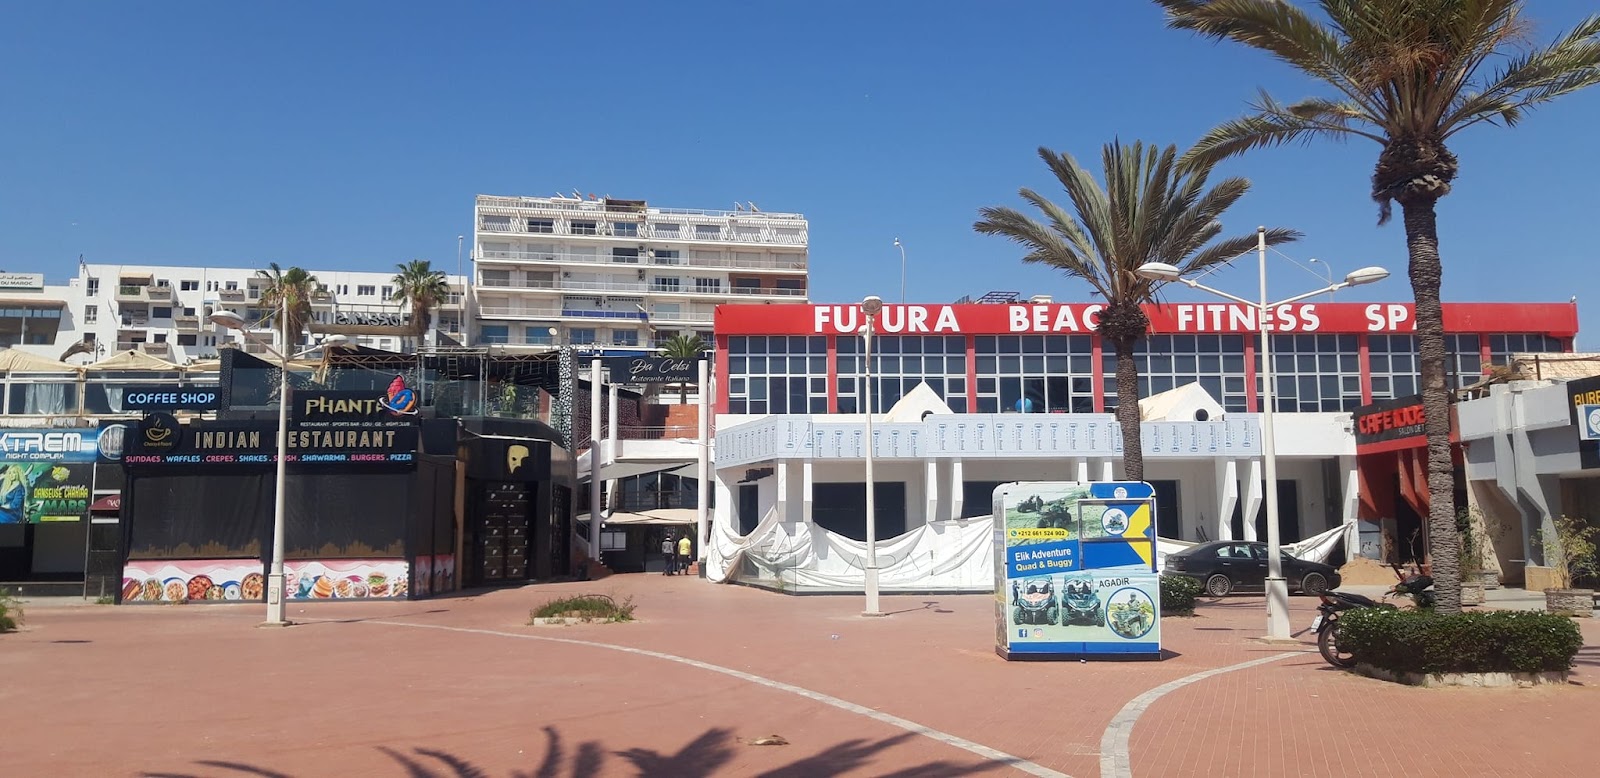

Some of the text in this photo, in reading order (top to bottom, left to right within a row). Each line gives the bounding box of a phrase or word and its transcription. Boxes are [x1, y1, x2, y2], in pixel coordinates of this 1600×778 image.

[814, 304, 1417, 332] FUURA BEAC FITNESS SP
[629, 359, 692, 374] Da Celsi
[128, 393, 216, 404] COFFEE SHOP
[195, 432, 260, 448] INDIAN
[44, 500, 86, 512] MARS
[1015, 547, 1072, 561] Elik Adventure
[1016, 562, 1038, 572] Quad
[1047, 558, 1073, 571] Buggy
[1099, 577, 1130, 588] AGADIR
